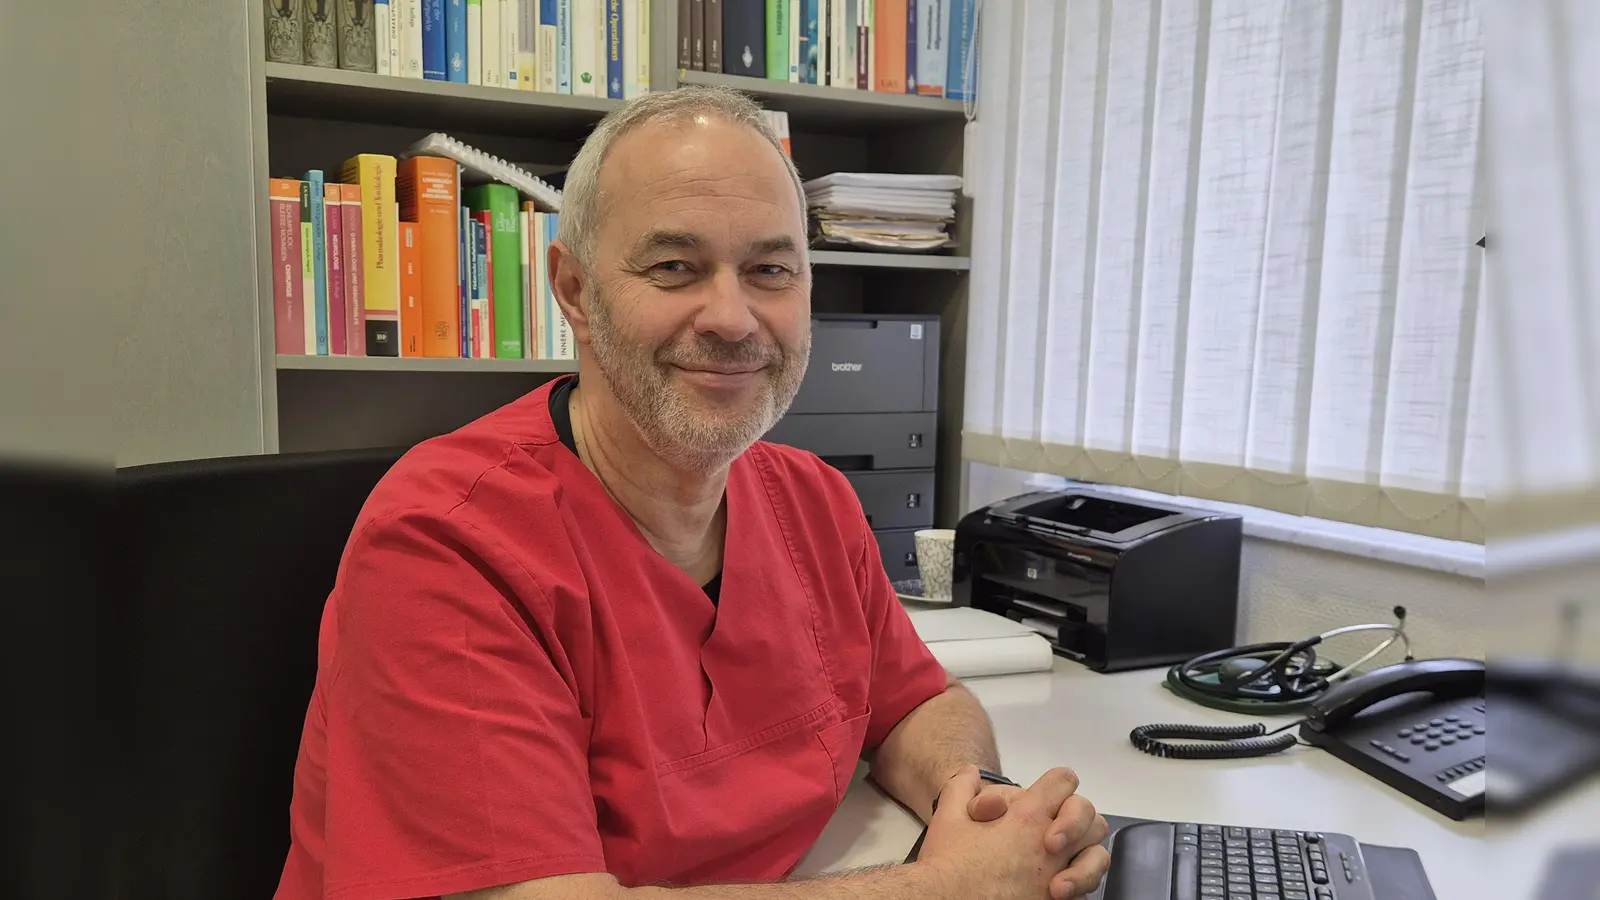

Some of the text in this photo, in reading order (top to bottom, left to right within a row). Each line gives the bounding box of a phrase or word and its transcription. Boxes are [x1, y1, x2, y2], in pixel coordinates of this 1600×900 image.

[373, 163, 384, 269] Pharmakologie und Toxikologie
[332, 234, 340, 271] NEUROLOGIE
[284, 264, 293, 298] CHIRURGIE
[559, 328, 567, 356] INNERE
[831, 362, 862, 372] brother
